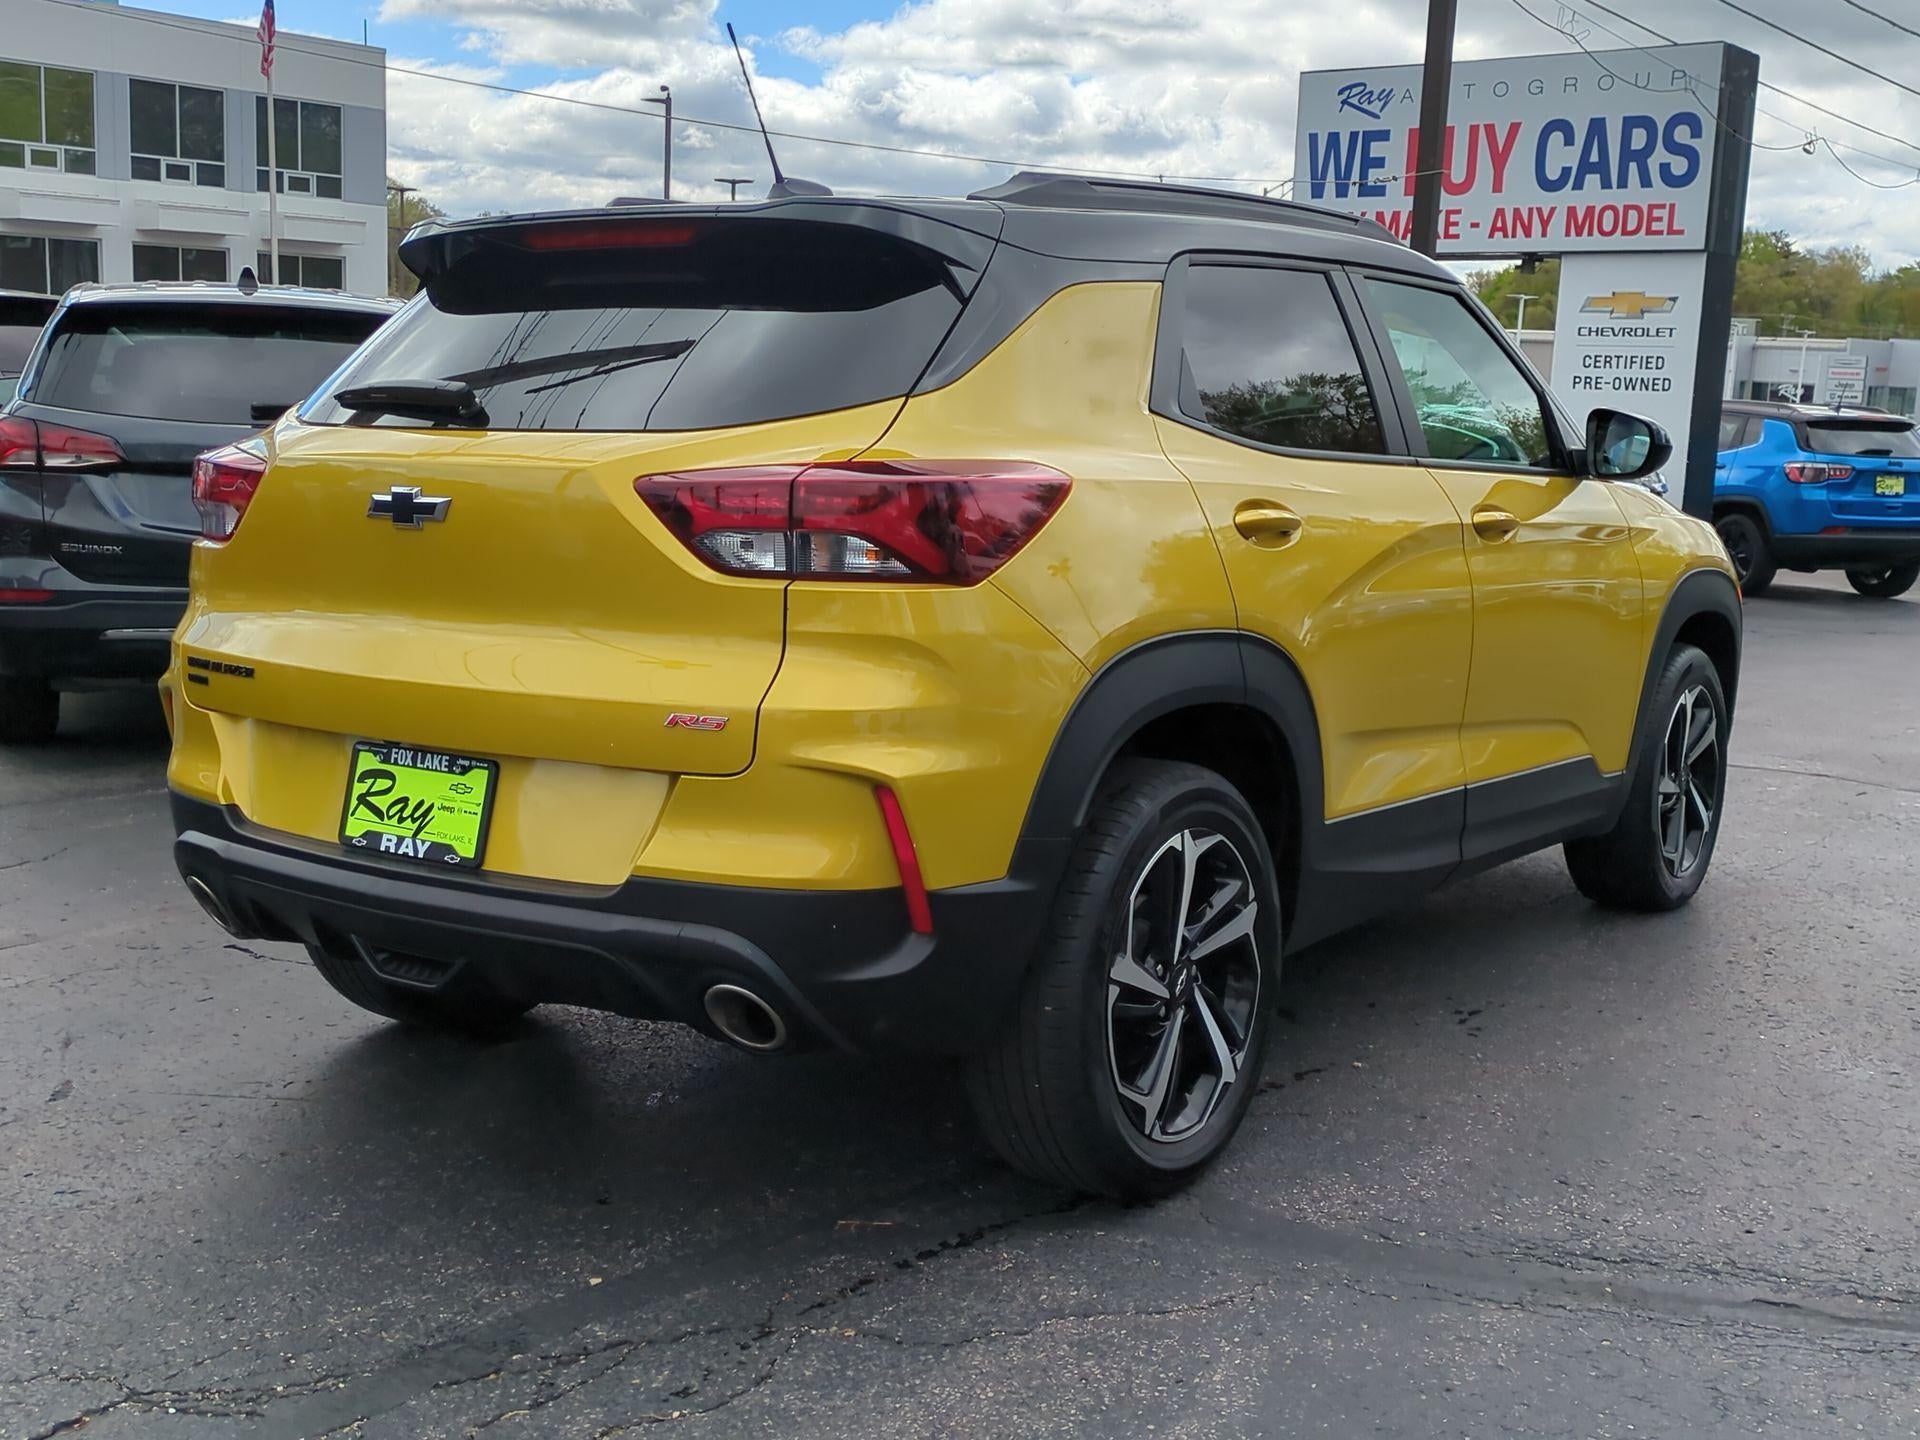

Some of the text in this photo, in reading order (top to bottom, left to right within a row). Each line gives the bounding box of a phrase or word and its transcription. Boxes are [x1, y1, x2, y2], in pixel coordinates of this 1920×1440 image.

[1337, 69, 1686, 120] Ray ATOGROUP
[1308, 129, 1391, 200] WE
[1534, 111, 1703, 193] CARS
[1487, 206, 1557, 239] ANY
[1564, 203, 1685, 237] MODEL
[1577, 326, 1677, 338] CHEVROLET
[1582, 354, 1665, 370] CERTIFIED
[1572, 375, 1672, 392] PRE-OWNED
[61, 543, 123, 554] EQUINOX
[663, 713, 729, 731] RS
[391, 748, 413, 766] FOX
[416, 751, 450, 772] LAKE
[350, 768, 435, 838] Ray
[437, 802, 456, 815] Jeep
[436, 831, 448, 839] FOX
[380, 834, 432, 858] RAY
